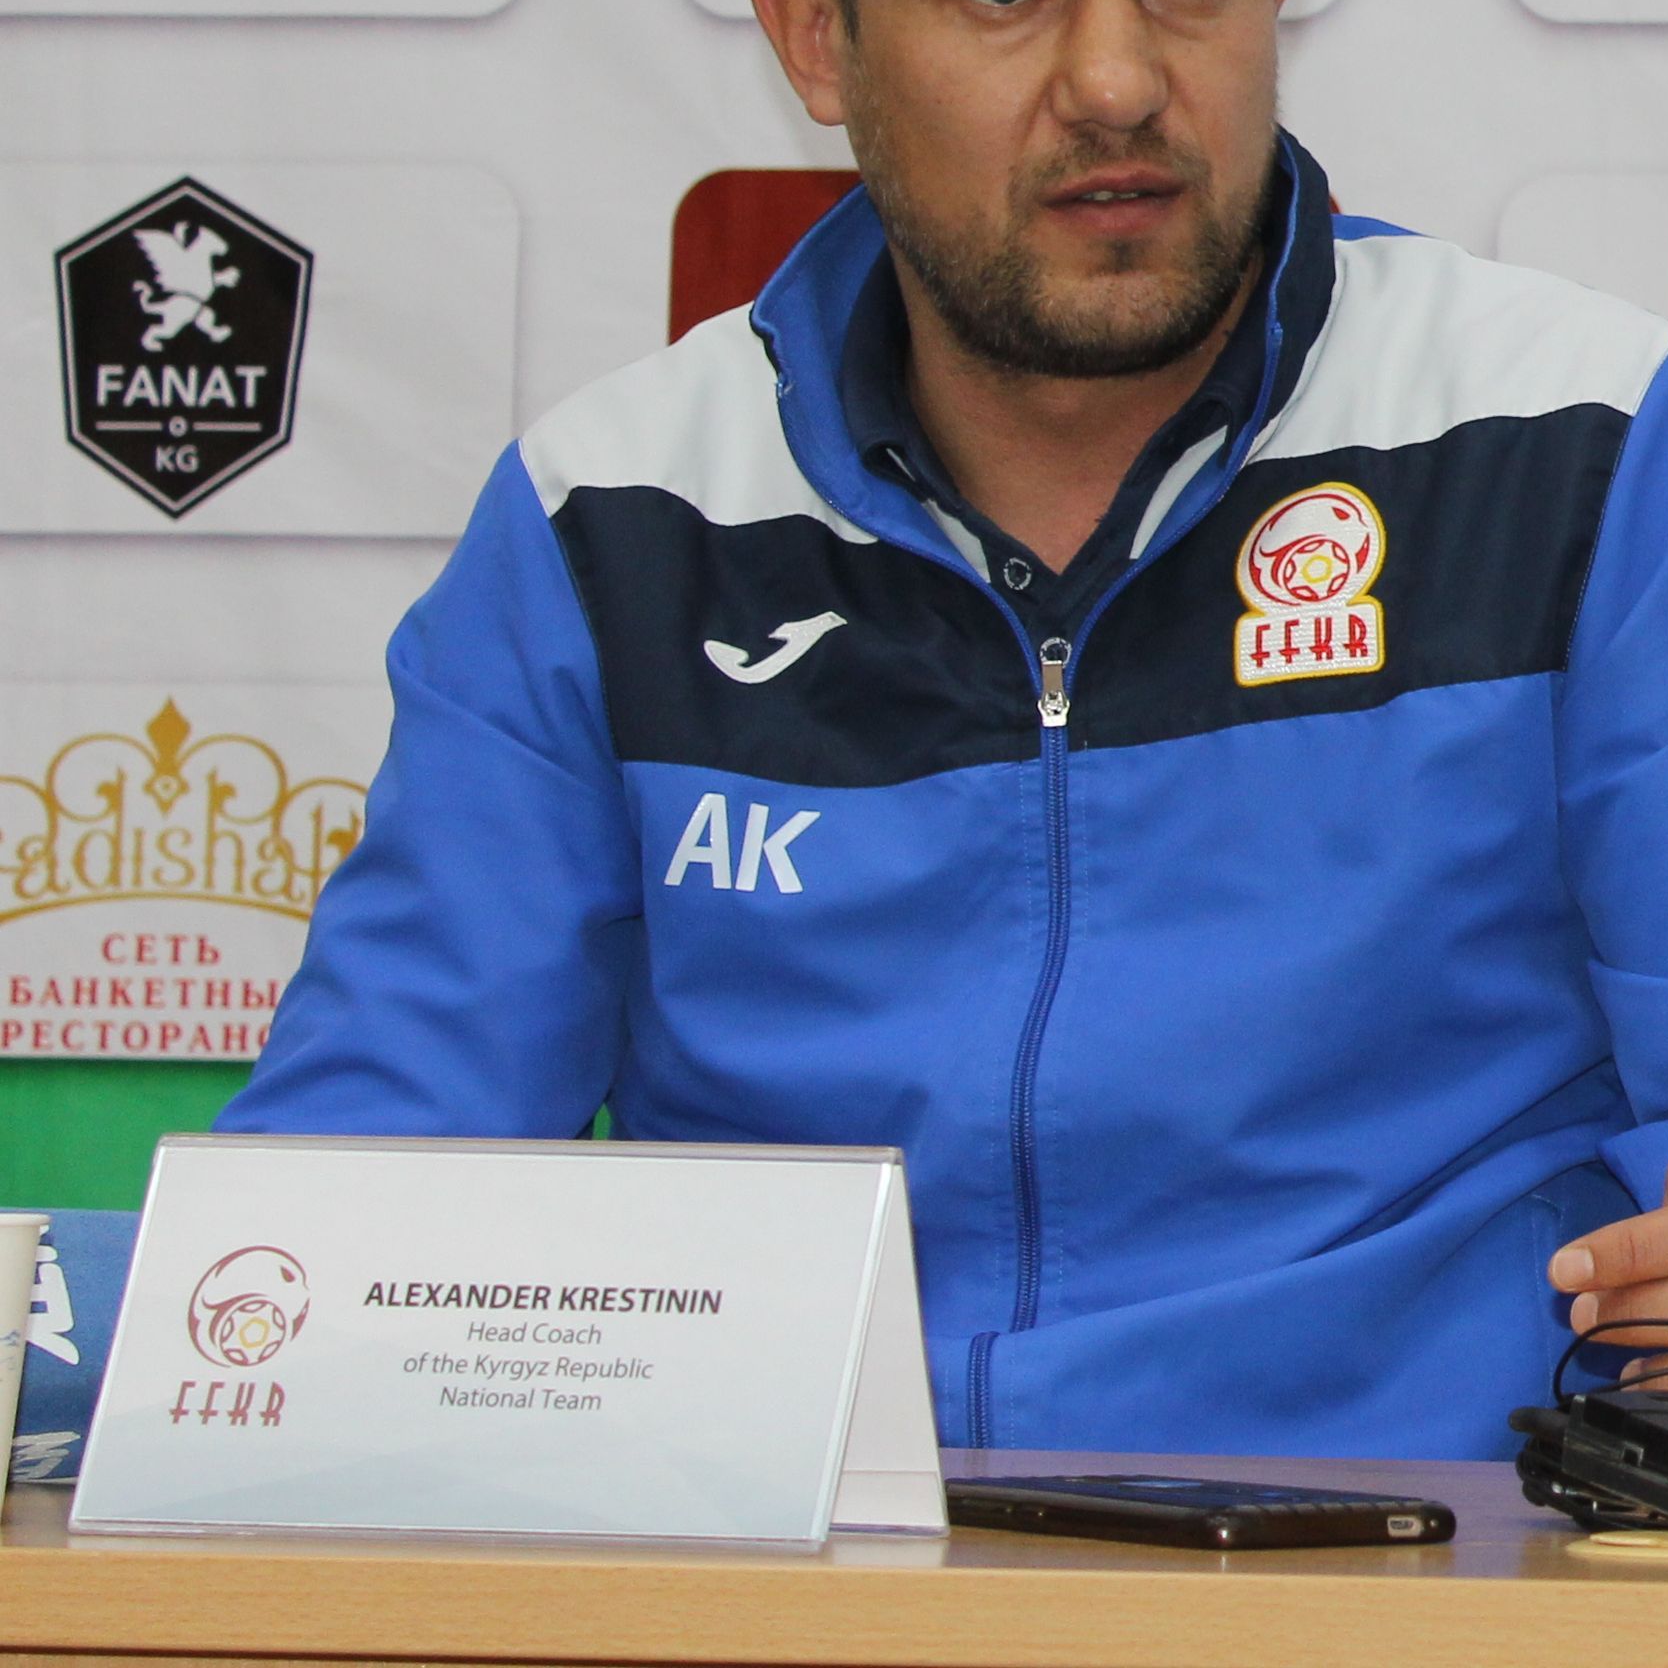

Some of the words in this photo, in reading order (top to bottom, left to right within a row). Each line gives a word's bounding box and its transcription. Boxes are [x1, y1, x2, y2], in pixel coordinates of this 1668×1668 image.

[95, 364, 267, 409] FANAT
[154, 443, 199, 474] KG
[1249, 614, 1370, 670] FFKR
[664, 793, 821, 894] AK
[101, 933, 222, 966] СЕТЬ
[9, 975, 278, 1011] БАНКЕТНЫ
[0, 1019, 270, 1054] РЕСТОРАН
[363, 1281, 552, 1311] ALEXANDER
[558, 1286, 723, 1315] KRESTININ
[466, 1321, 528, 1343] Head
[531, 1322, 603, 1345] Coach
[402, 1352, 430, 1374] of
[431, 1353, 469, 1375] the
[473, 1354, 551, 1381] Kyrgyz
[554, 1356, 655, 1383] Republic
[168, 1380, 286, 1427] FFKR
[439, 1385, 536, 1409] National
[541, 1388, 603, 1411] Team
